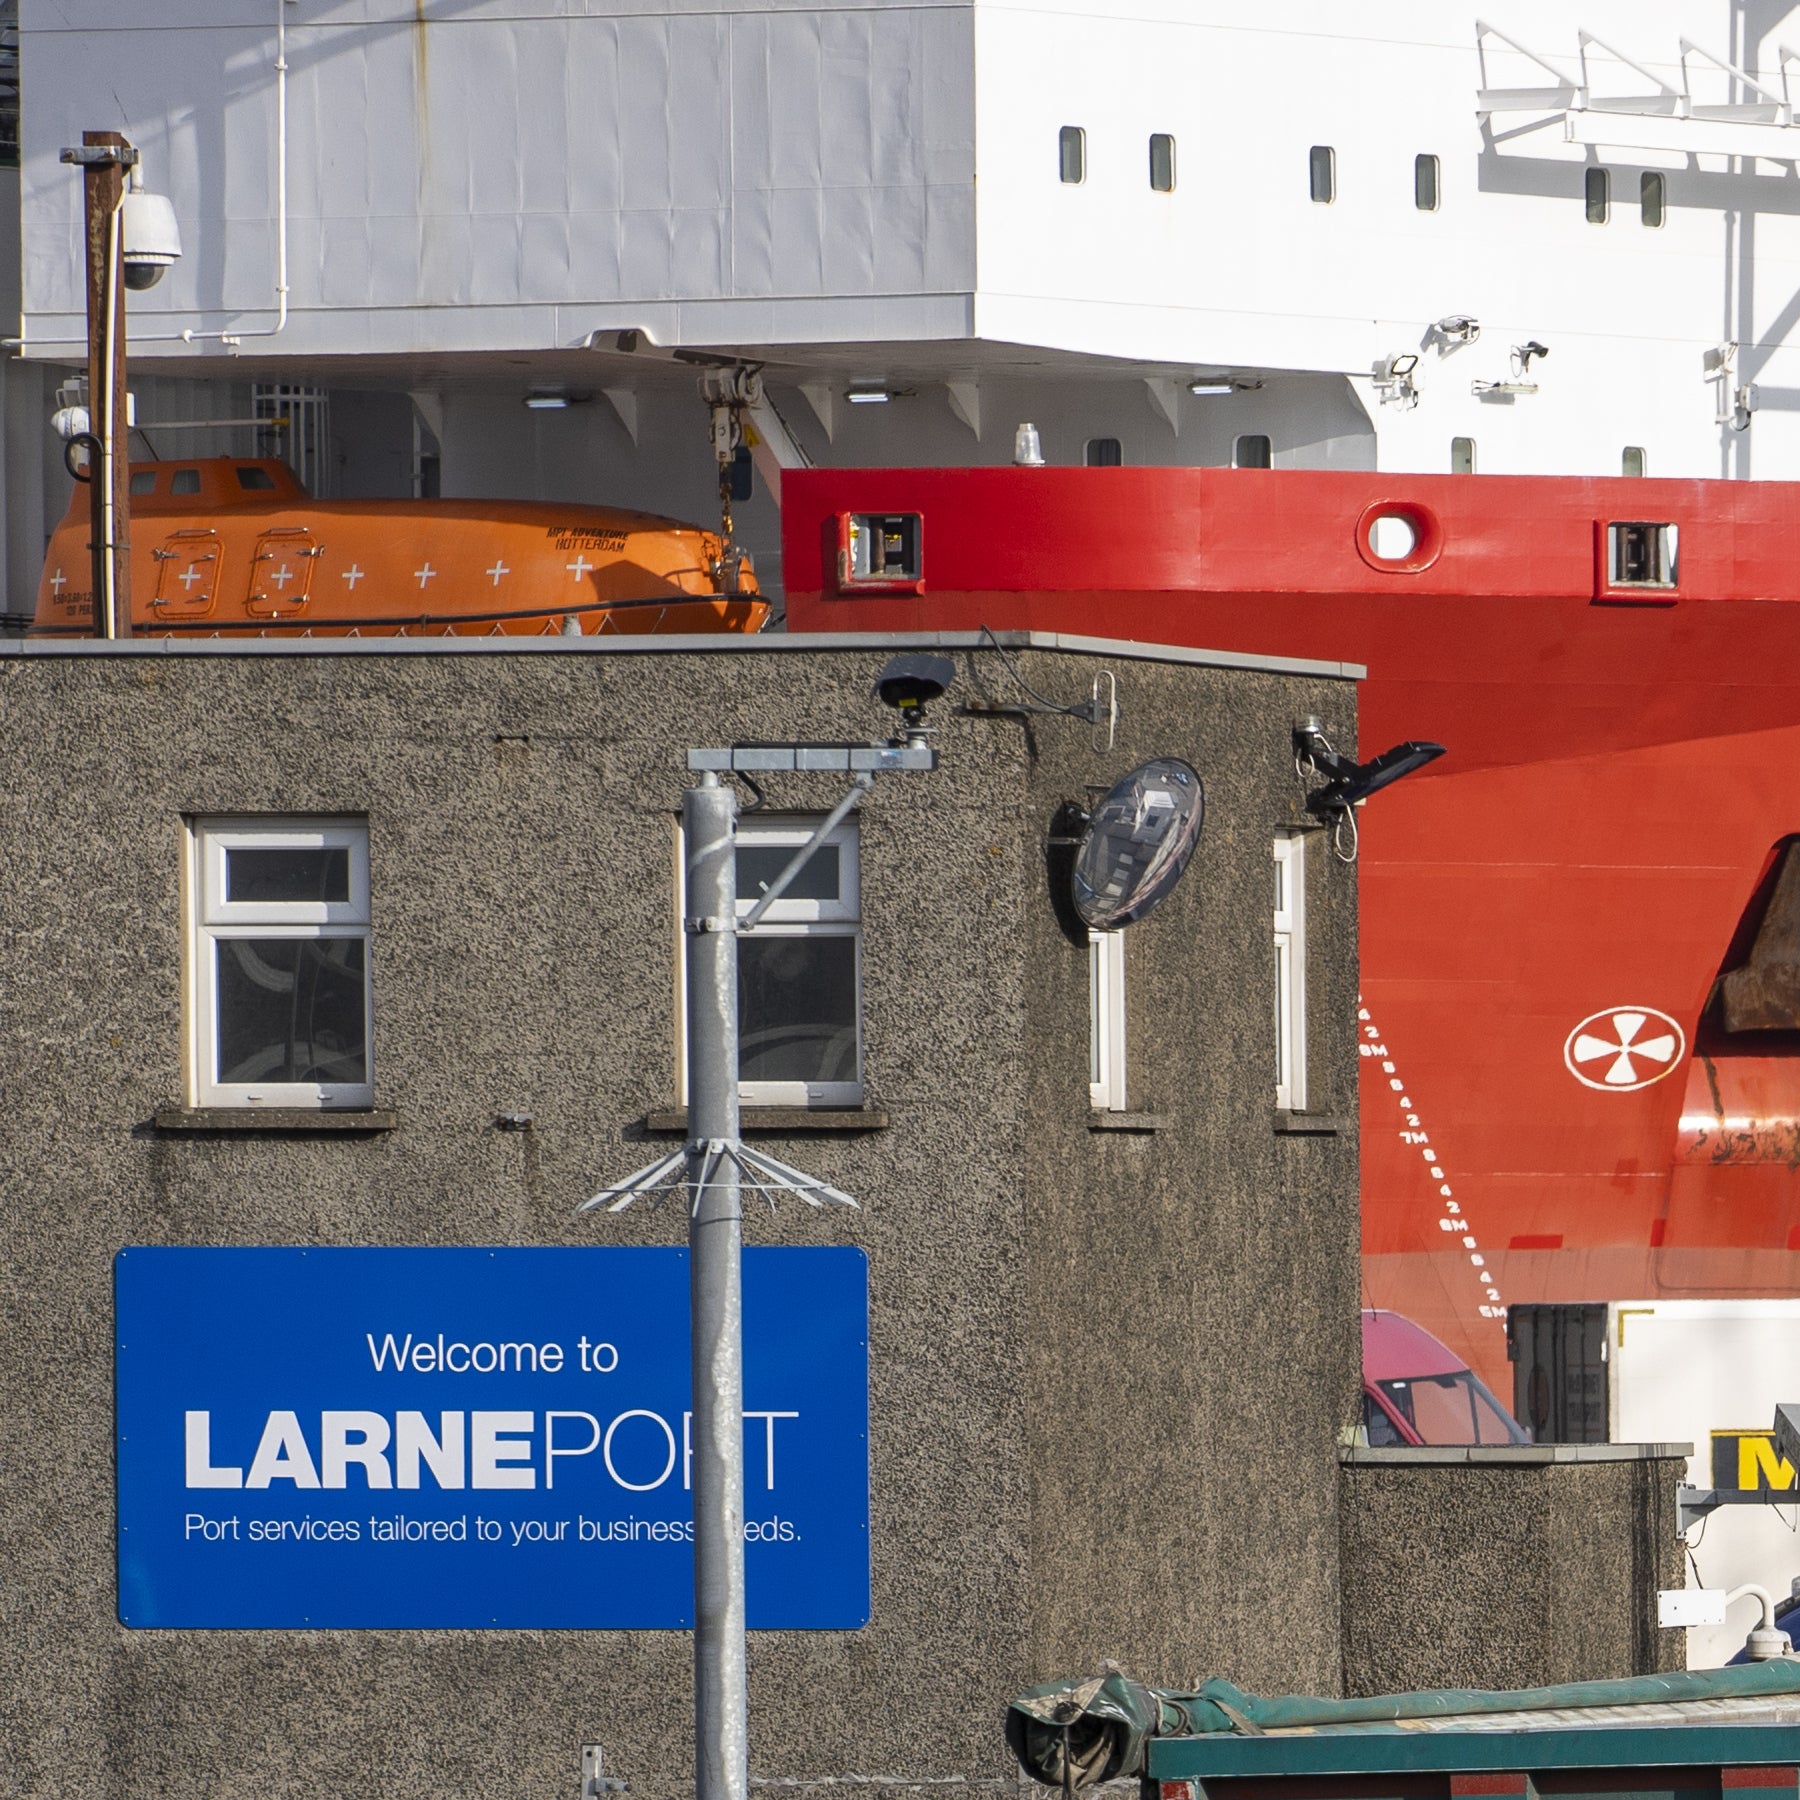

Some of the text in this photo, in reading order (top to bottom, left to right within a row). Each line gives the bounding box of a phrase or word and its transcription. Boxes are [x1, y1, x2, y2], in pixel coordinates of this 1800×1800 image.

[366, 1333, 618, 1372] Welcome to
[184, 1409, 800, 1492] LARNEPOT
[186, 1514, 694, 1546] Port services tailored to your business
